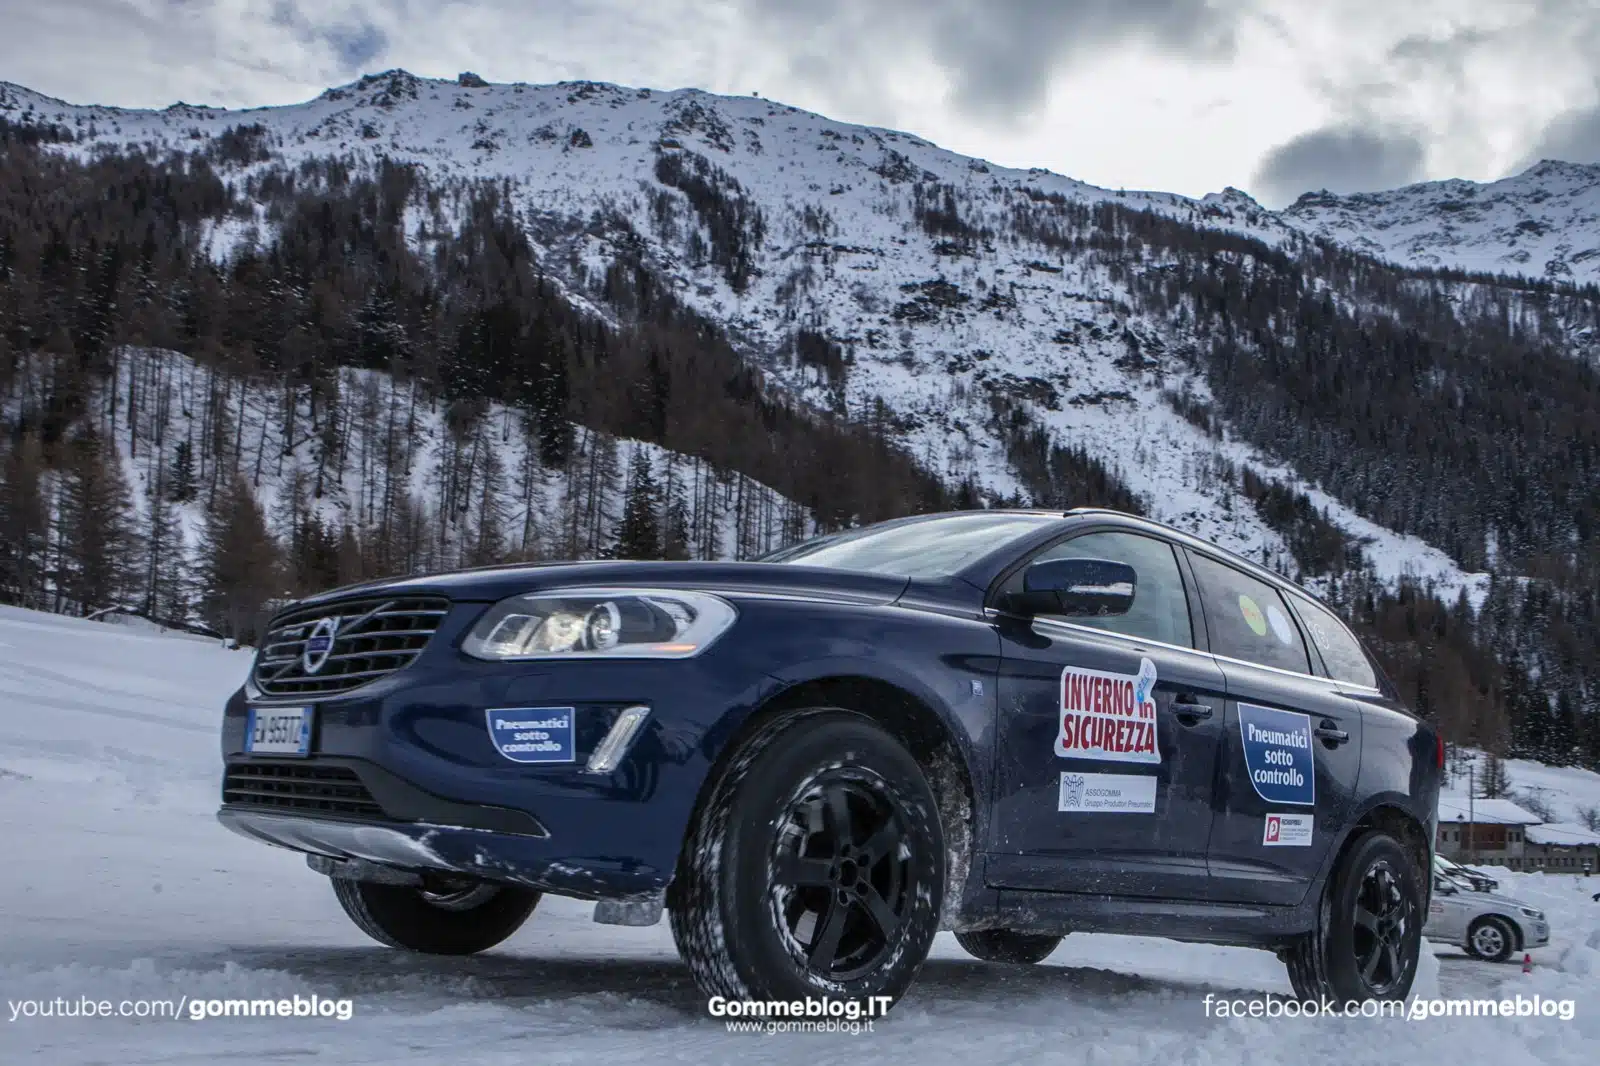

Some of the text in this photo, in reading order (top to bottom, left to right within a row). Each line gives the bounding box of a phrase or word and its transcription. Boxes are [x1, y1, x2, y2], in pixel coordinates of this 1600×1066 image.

[1064, 672, 1135, 717] INVERNO
[495, 718, 569, 730] Pneumatici
[513, 731, 550, 741] sotto
[1062, 714, 1155, 754] SICUREZZA
[1248, 723, 1308, 749] Pneumatici
[502, 740, 562, 752] controllo
[1264, 749, 1294, 766] sotto
[1254, 768, 1304, 787] controllo
